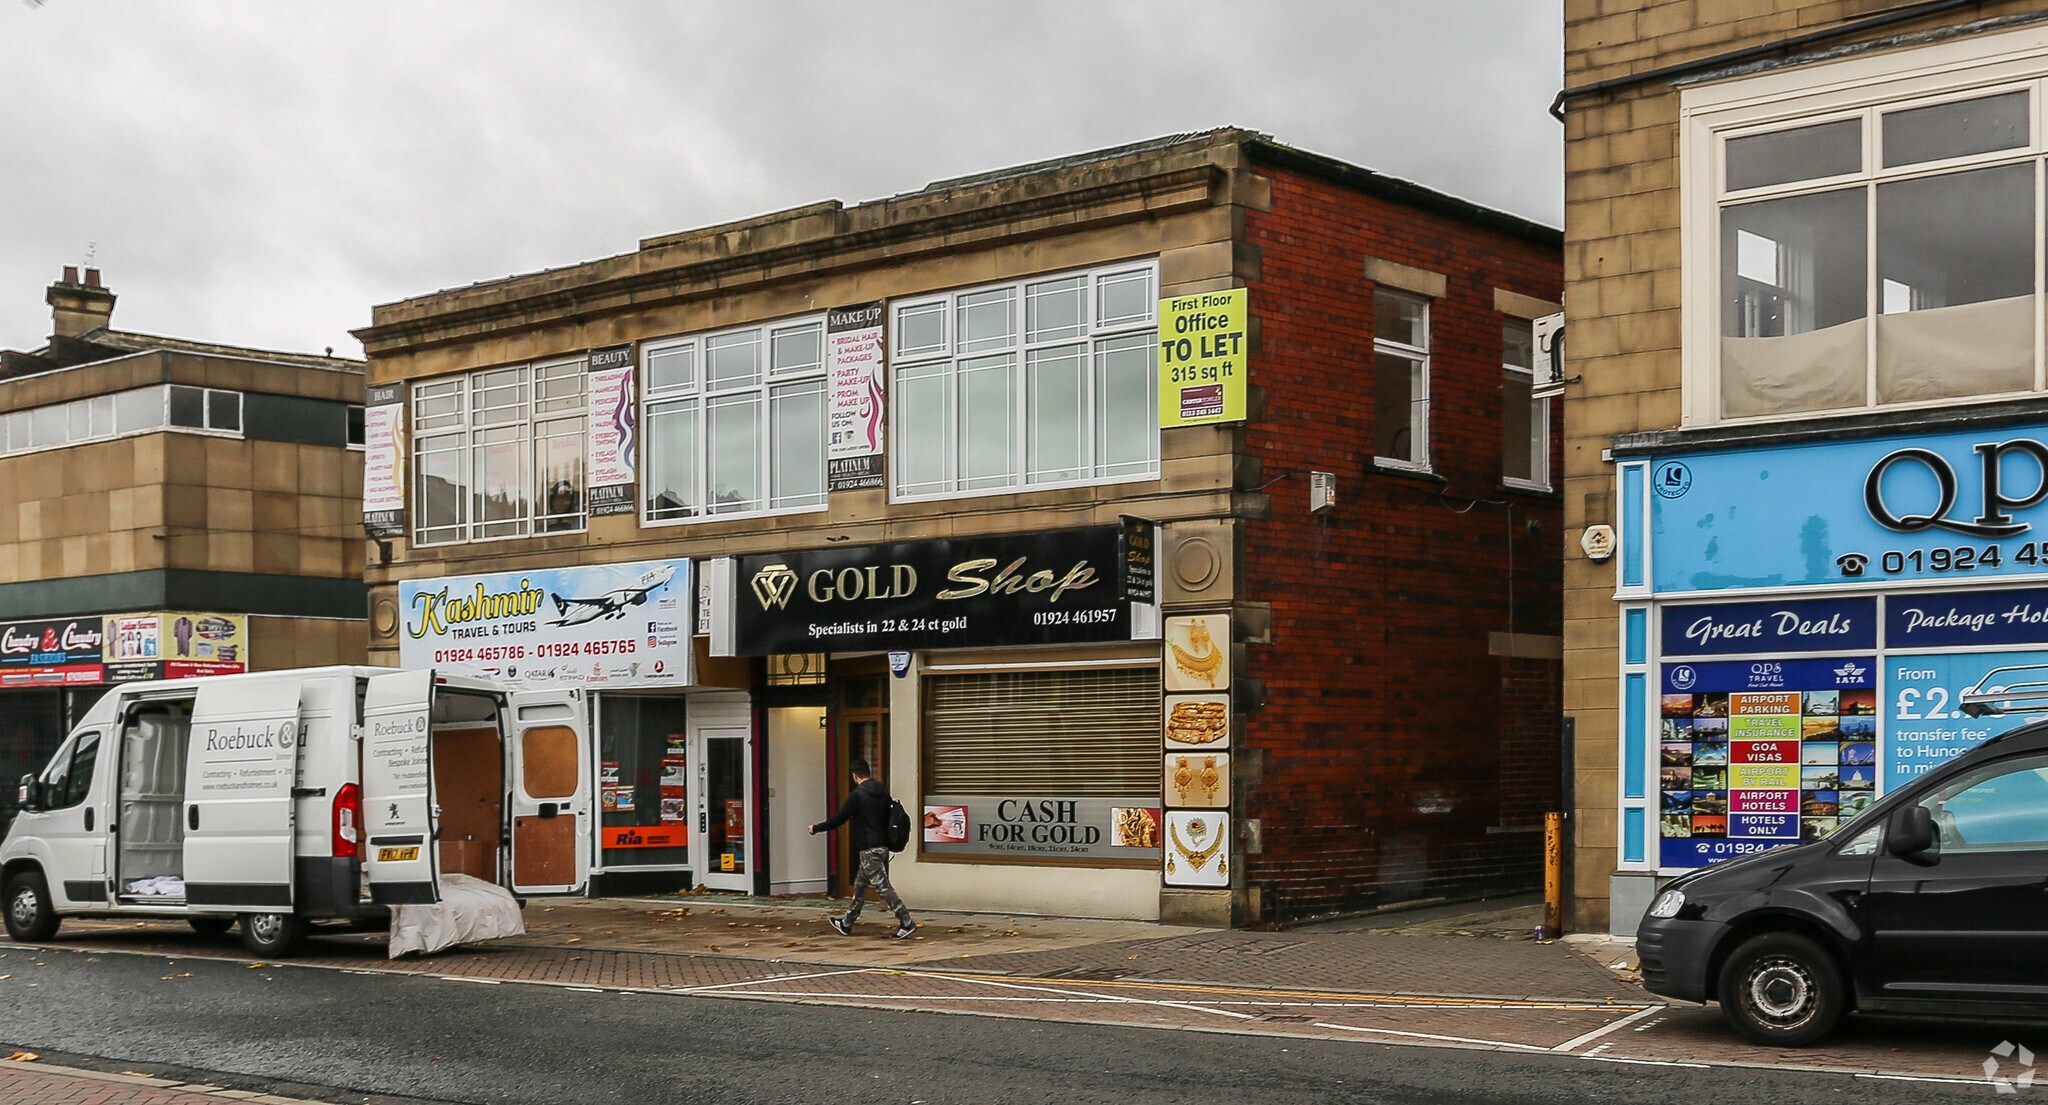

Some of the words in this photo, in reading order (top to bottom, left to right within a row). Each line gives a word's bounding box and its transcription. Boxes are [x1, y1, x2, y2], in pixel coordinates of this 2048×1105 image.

[1172, 298, 1198, 312] First
[1202, 295, 1232, 308] Floor
[830, 311, 864, 326] MAKE
[866, 308, 881, 320] UP
[1175, 313, 1229, 333] Office
[837, 335, 860, 345] BRIDAL
[862, 333, 877, 341] HAIR
[844, 343, 874, 353] MAKE-UP
[1162, 338, 1192, 363] TO
[1201, 331, 1243, 358] LET
[592, 350, 630, 366] BEAUTY
[837, 353, 872, 365] PACKAGES
[837, 368, 859, 377] PARTY
[1172, 366, 1196, 383] 315
[1201, 367, 1217, 382] sq
[1222, 361, 1233, 376] ft
[837, 376, 870, 387] MAKE-UP
[374, 390, 394, 401] HAIR
[837, 390, 858, 398] PROM
[837, 398, 858, 408] MAKE
[860, 397, 870, 405] UP
[832, 410, 857, 420] FOLLOW
[830, 457, 870, 474] PLATINUM
[591, 486, 623, 500] PLATINUM
[1881, 544, 2003, 574] 01924
[808, 564, 918, 603] GOLD
[936, 556, 1099, 603] Shop
[407, 579, 544, 639] Kashmir
[1033, 611, 1070, 626] 01924
[1072, 608, 1117, 624] 461957
[1902, 608, 1995, 633] Package
[452, 626, 489, 640] TRAVEL
[492, 625, 499, 636] &
[502, 621, 536, 634] TOURS
[808, 621, 865, 639] Specialists
[866, 620, 878, 634] in
[881, 619, 896, 632] 22
[898, 618, 909, 631] &
[911, 618, 926, 631] 24
[928, 618, 939, 631] ct
[942, 616, 967, 633] gold
[1685, 615, 1762, 646] Great
[1770, 610, 1852, 636] Deals
[435, 649, 473, 663] 01924
[477, 646, 524, 660] 465786
[537, 642, 579, 657] 01924
[584, 639, 636, 654] 465765
[1751, 663, 1782, 675] QPS
[1898, 667, 1936, 681] From
[1835, 676, 1865, 684] IATA
[1740, 695, 1790, 704] AIRPORT
[1740, 705, 1790, 714] PARKING
[374, 719, 414, 736] Roebuck
[1745, 719, 1784, 727] TRAVEL
[206, 725, 274, 751] Roebuck
[280, 722, 296, 748] &
[1735, 728, 1795, 737] INSURANCE
[1896, 728, 1958, 741] transfer
[1751, 743, 1778, 751] GOA
[1896, 746, 1913, 758] to
[1746, 753, 1783, 762] VISAS
[1740, 767, 1789, 776] AIRPORT
[1896, 762, 1910, 774] in
[1742, 778, 1756, 786] BY
[1760, 777, 1786, 786] RAIL
[1739, 792, 1789, 800] AIRPORT
[998, 799, 1078, 823] CASH
[1742, 802, 1786, 810] HOTELS
[1741, 816, 1786, 824] HOTELS
[978, 823, 1025, 842] FOR
[1031, 824, 1100, 844] GOLD
[1748, 826, 1778, 835] ONLY
[616, 829, 643, 845] Ria
[1714, 843, 1764, 854] 01924
